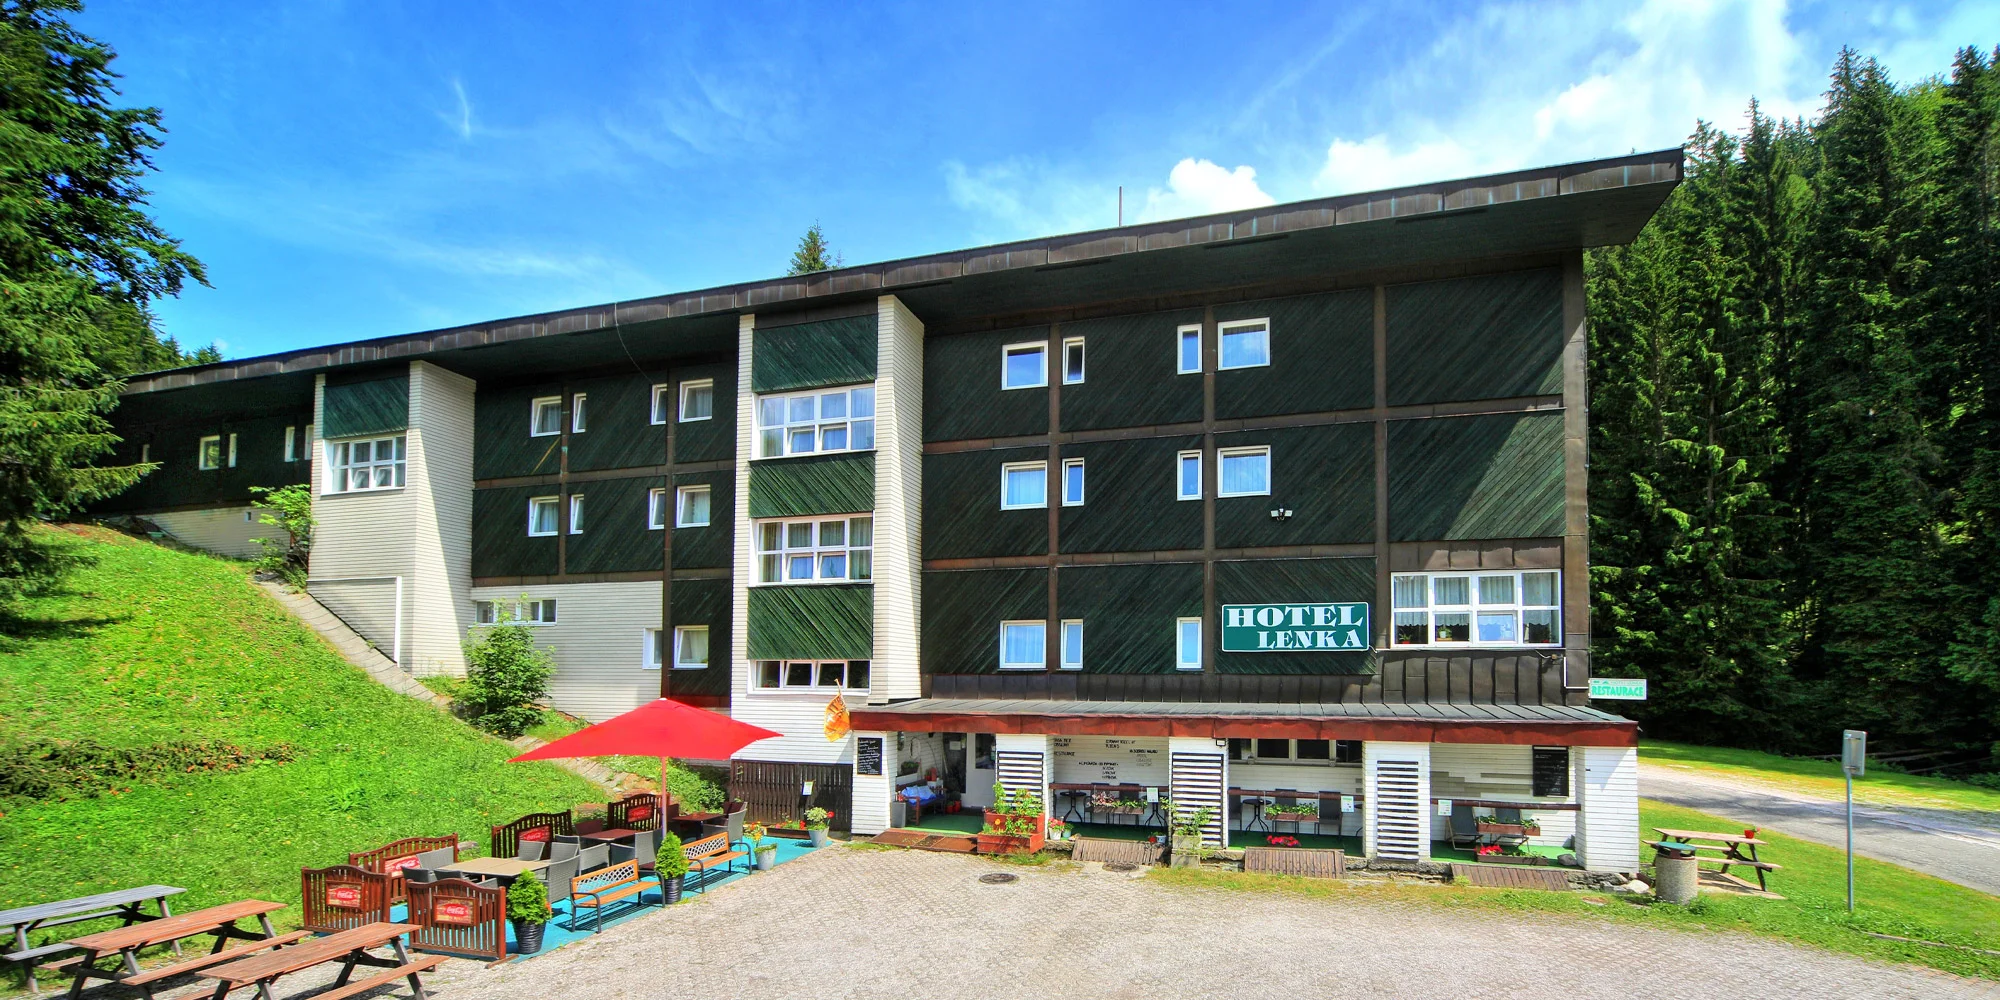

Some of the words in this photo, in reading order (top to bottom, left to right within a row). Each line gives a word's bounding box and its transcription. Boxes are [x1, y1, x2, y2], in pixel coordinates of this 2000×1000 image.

[1226, 605, 1364, 627] HOTEL
[1257, 629, 1364, 649] LENKA
[1591, 686, 1644, 697] RESTAURACE
